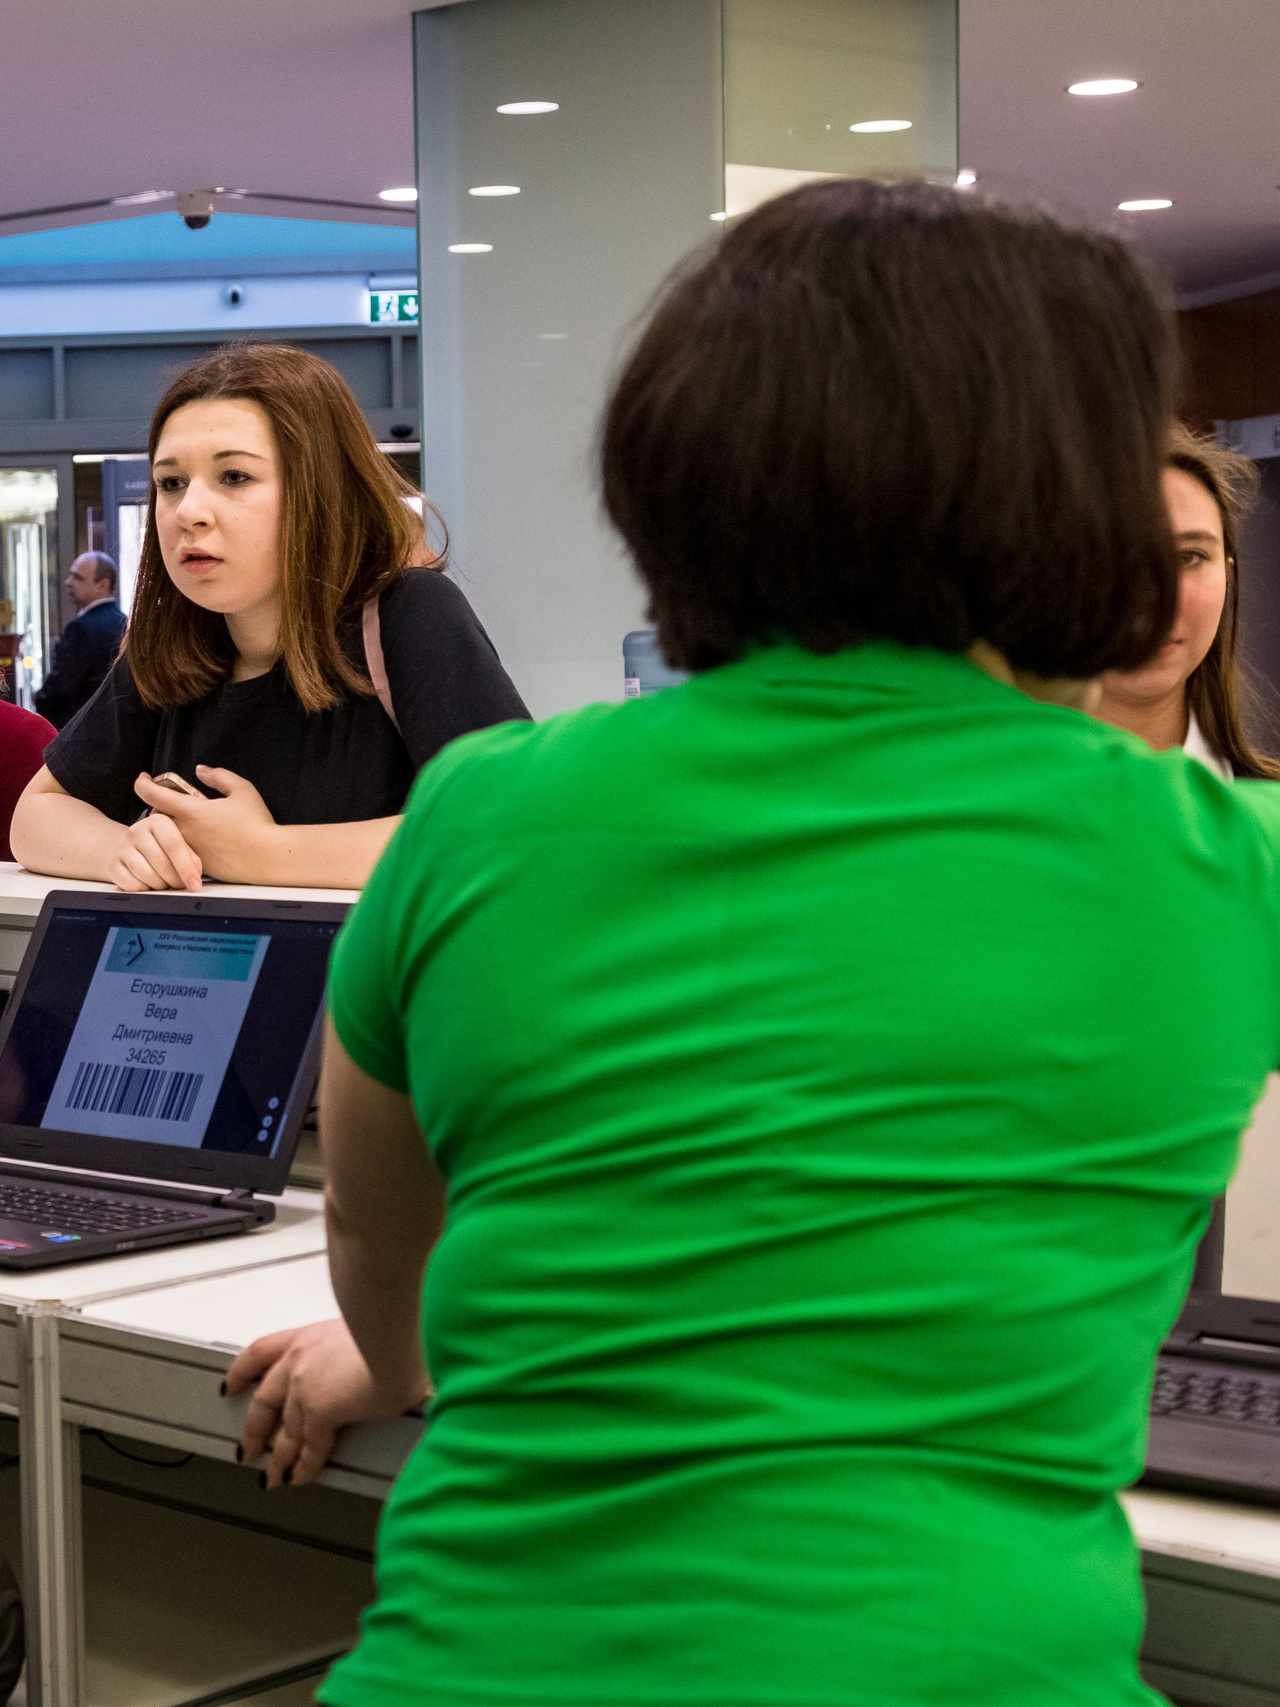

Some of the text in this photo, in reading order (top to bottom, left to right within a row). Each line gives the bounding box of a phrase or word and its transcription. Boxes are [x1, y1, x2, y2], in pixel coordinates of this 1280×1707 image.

[130, 978, 208, 999] Егорушкина
[144, 1002, 178, 1022] Вера
[111, 1023, 194, 1046] Дмитриевна
[125, 1047, 167, 1066] 34265
